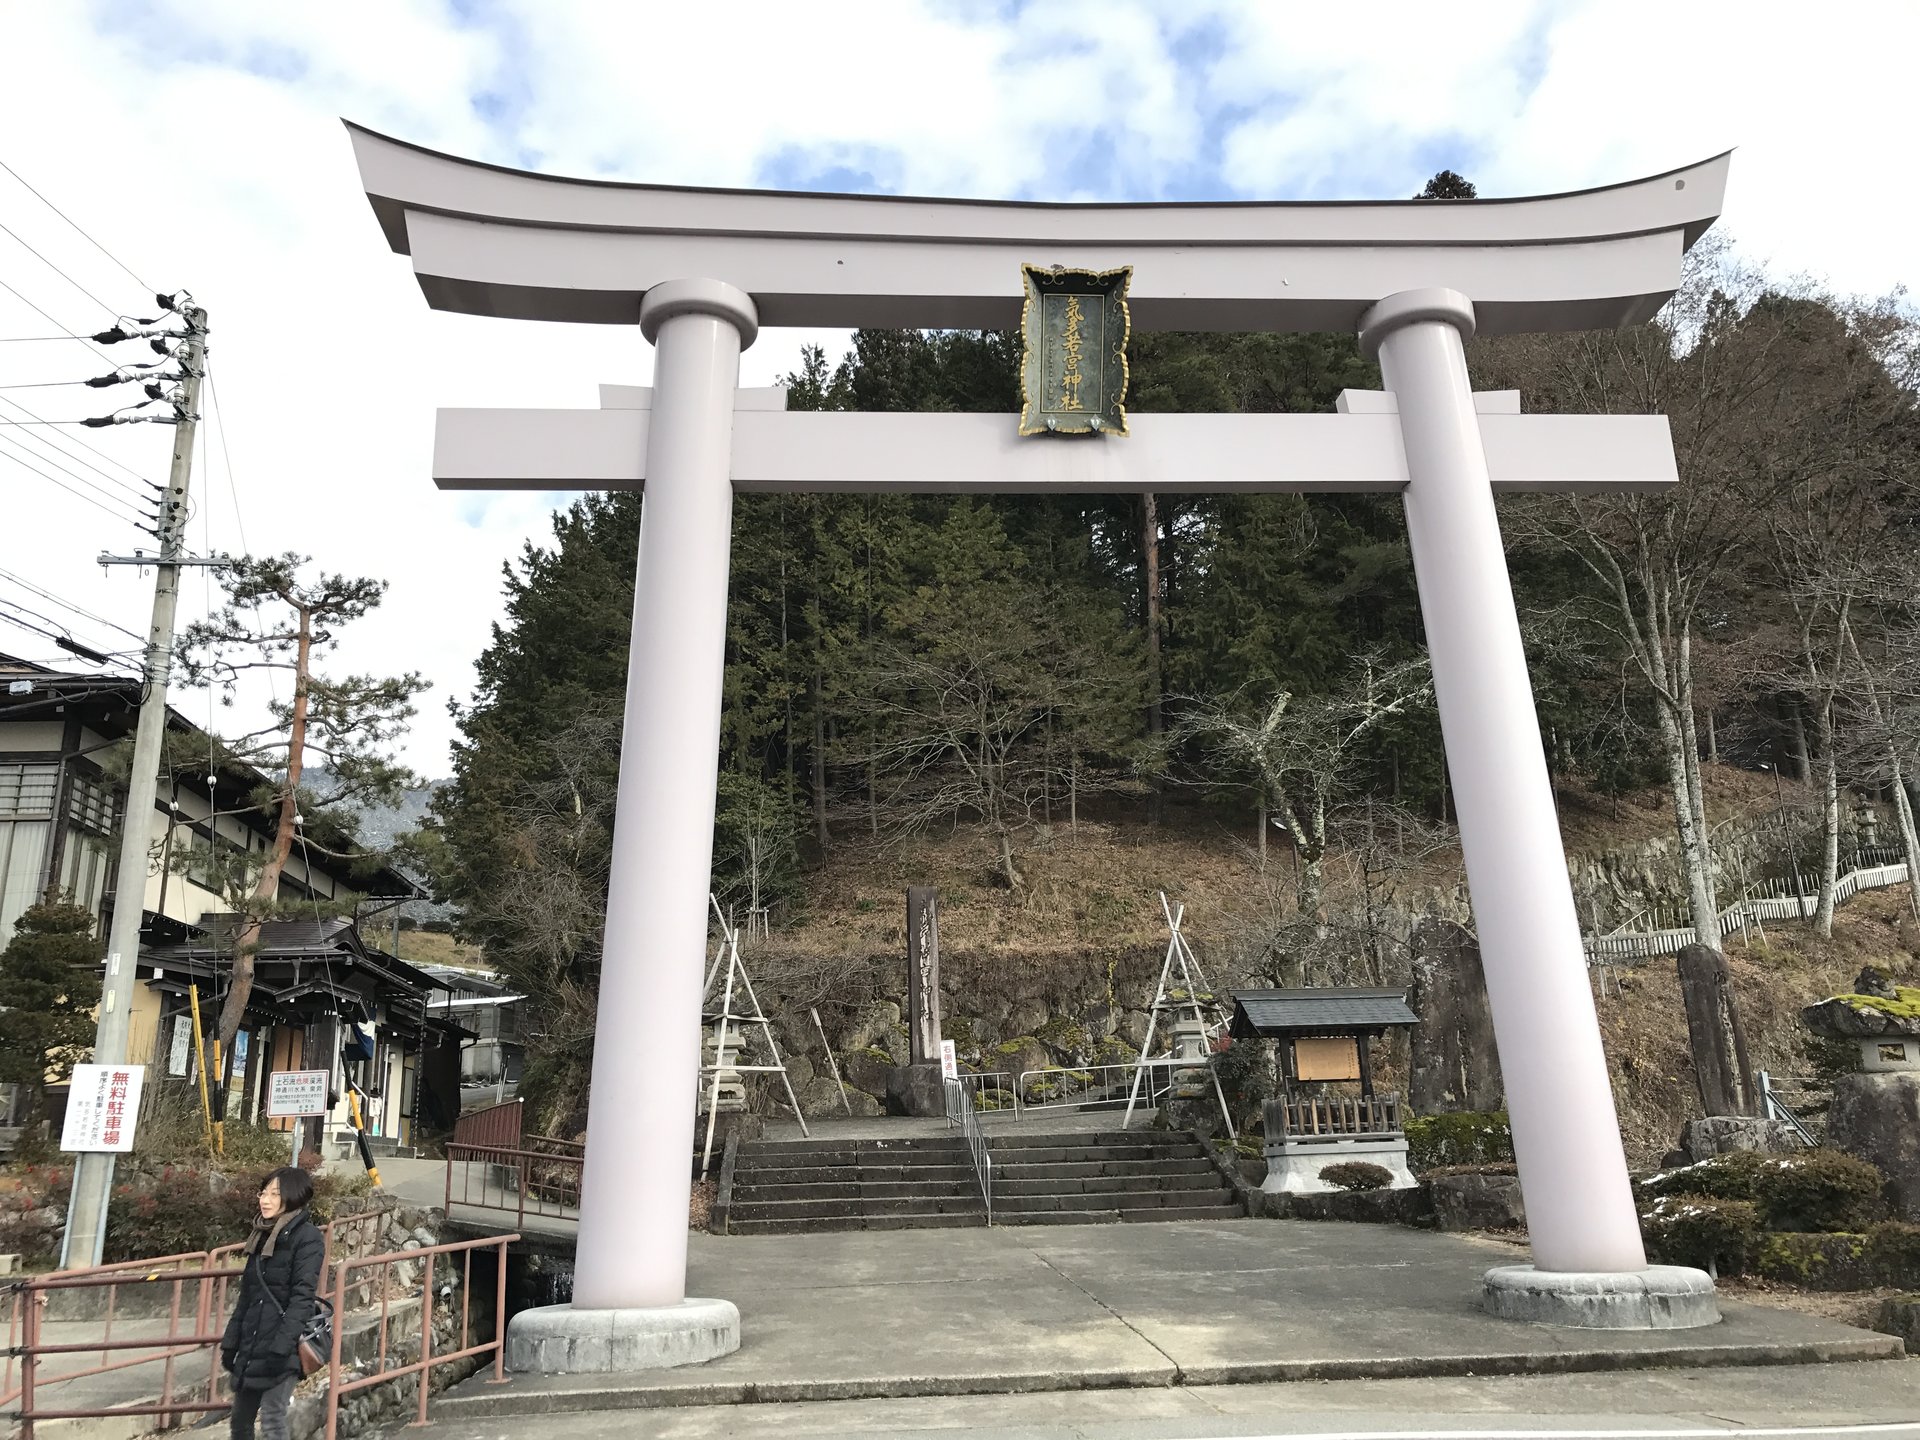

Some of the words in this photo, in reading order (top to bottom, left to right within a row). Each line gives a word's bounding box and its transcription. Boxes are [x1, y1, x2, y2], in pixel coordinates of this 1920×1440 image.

[88, 1071, 109, 1146] 順序よく駐車してください
[102, 1071, 130, 1146] 無料駐車場
